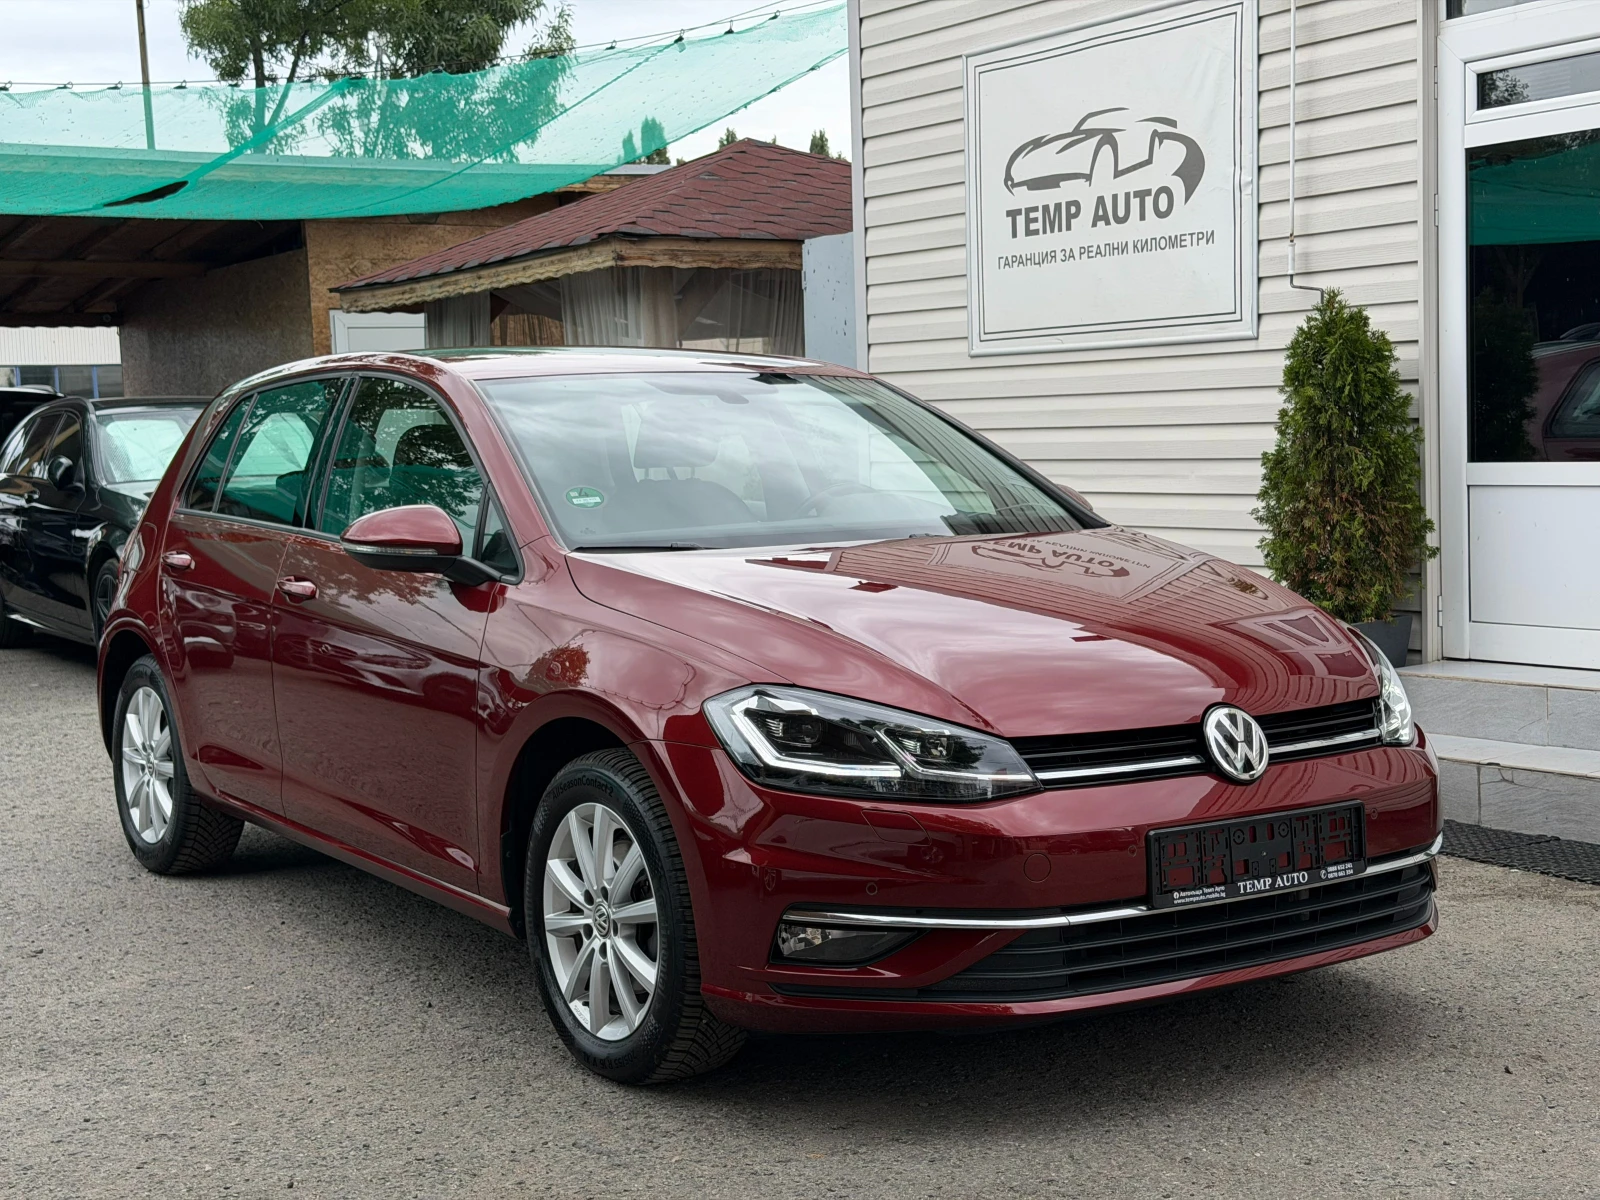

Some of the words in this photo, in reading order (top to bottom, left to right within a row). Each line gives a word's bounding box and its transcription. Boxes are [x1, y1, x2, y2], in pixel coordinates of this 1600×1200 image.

[1005, 199, 1082, 239] TEMP
[1090, 185, 1175, 229] AUTO
[997, 249, 1057, 270] ГАРАНЦИЯ
[1060, 248, 1076, 263] ЗА
[1079, 240, 1129, 260] РЕАЛНИ
[1132, 229, 1215, 254] КИЛОМЕТРИ
[552, 774, 608, 800] AllSeasonContact
[608, 786, 614, 798] 2
[1237, 877, 1272, 895] TEMP
[1275, 871, 1309, 888] AUTO
